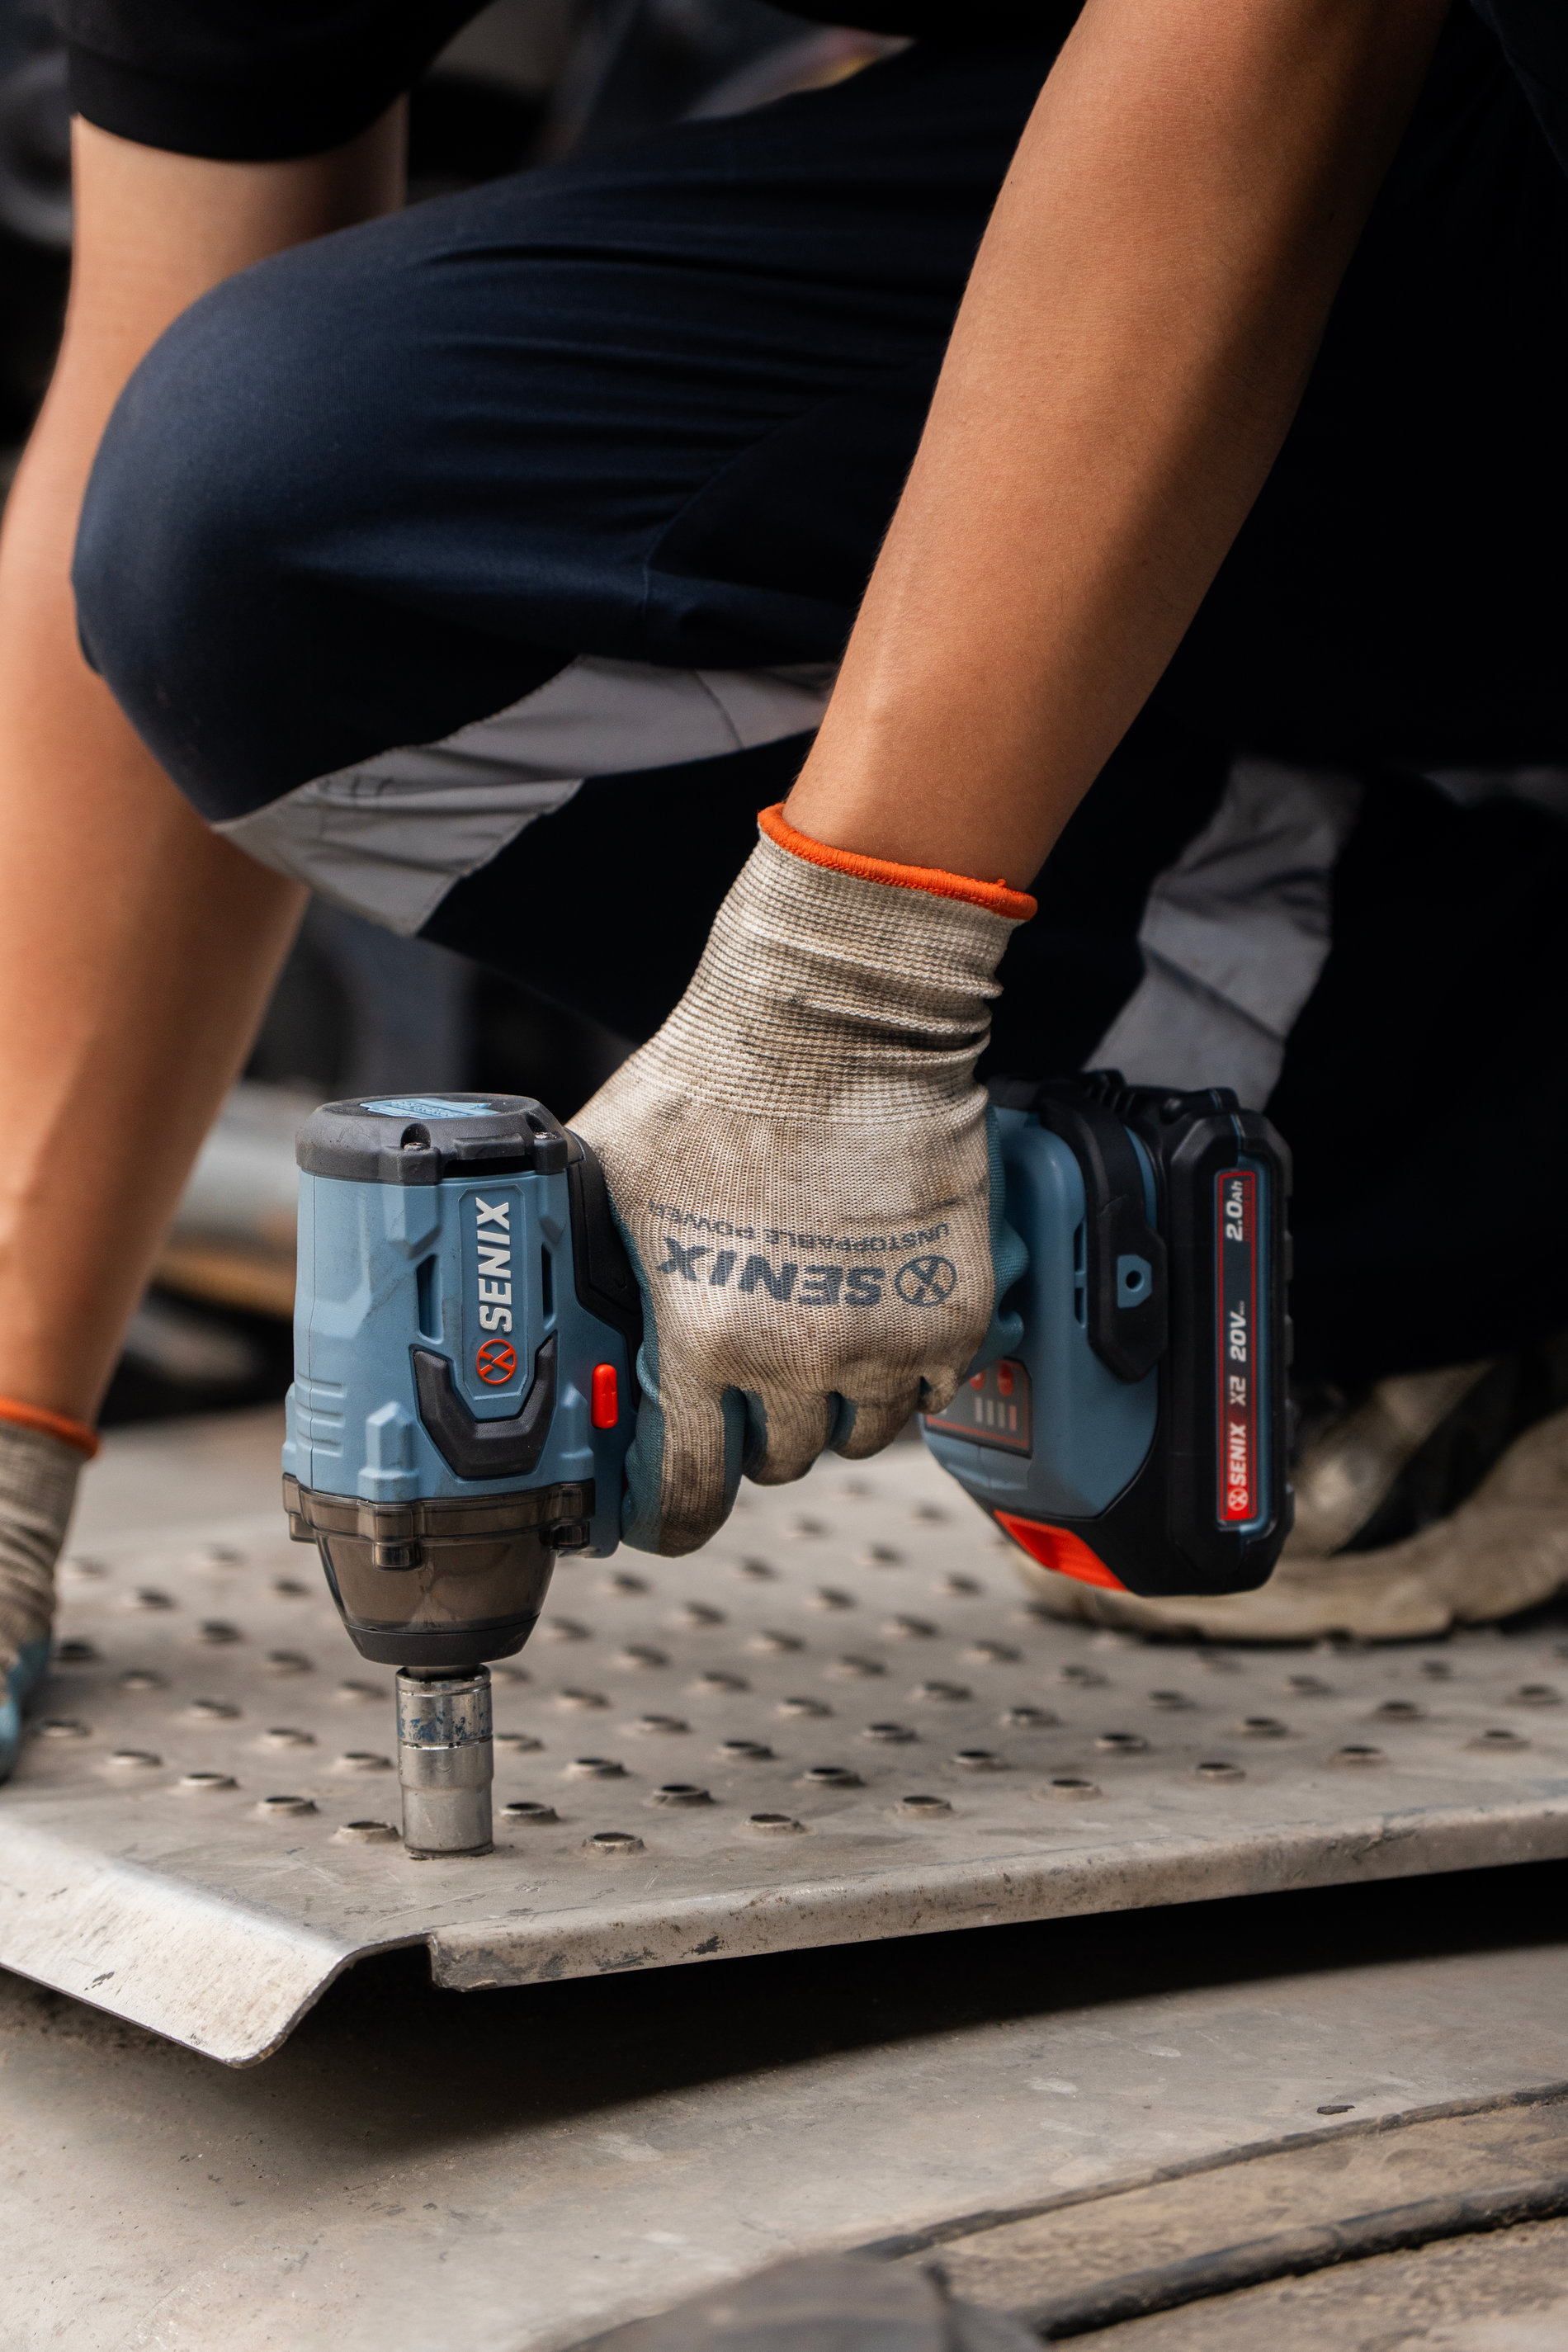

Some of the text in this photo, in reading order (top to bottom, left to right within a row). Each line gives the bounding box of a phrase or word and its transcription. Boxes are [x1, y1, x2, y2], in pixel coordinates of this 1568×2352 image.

[649, 1199, 950, 1253] UNSTOPPABLE POWER
[1226, 1180, 1244, 1242] 2.0Ah
[475, 1197, 512, 1333] SENIX
[658, 1237, 886, 1307] SENIX
[1229, 1375, 1247, 1406] X2
[1230, 1422, 1247, 1487] SENIX
